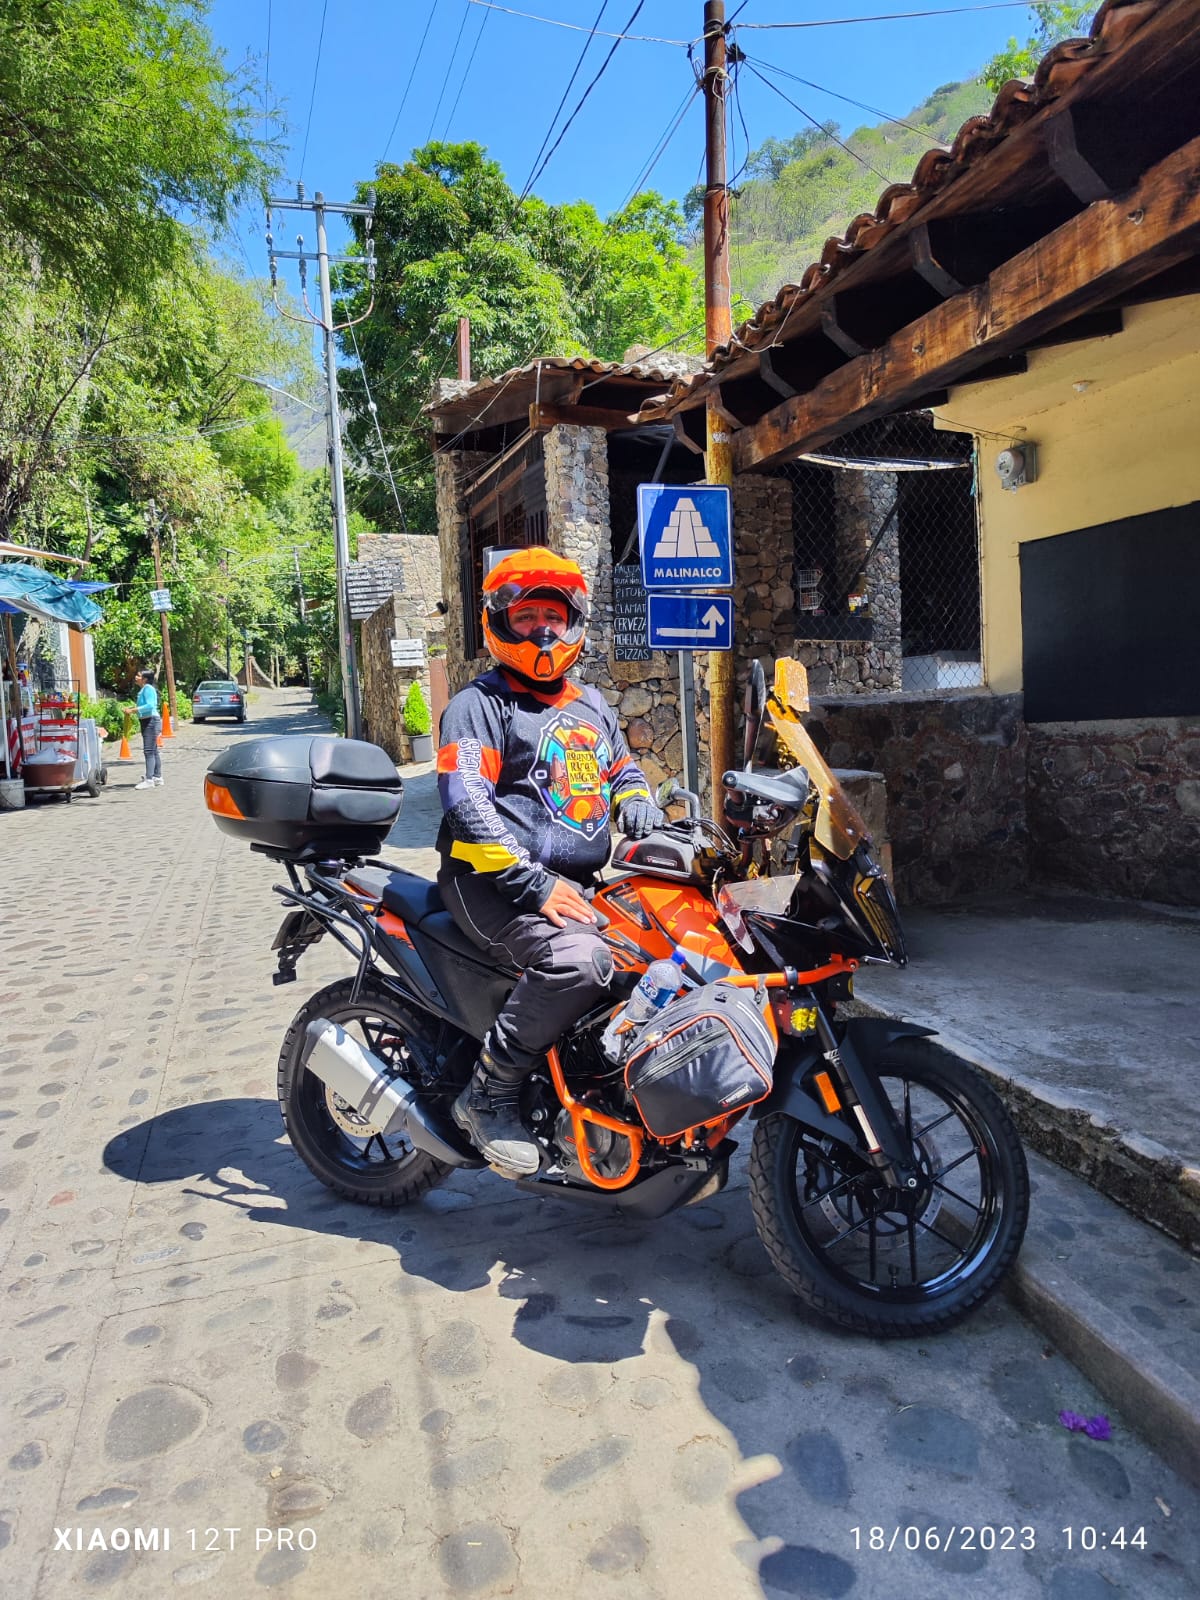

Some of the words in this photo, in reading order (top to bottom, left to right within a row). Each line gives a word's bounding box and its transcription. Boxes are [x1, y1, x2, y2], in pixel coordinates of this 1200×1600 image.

[654, 568, 722, 578] MALINALCO
[614, 603, 647, 614] CLAMAT
[615, 648, 649, 660] PIZZAS
[562, 718, 574, 727] N
[586, 823, 594, 832] S
